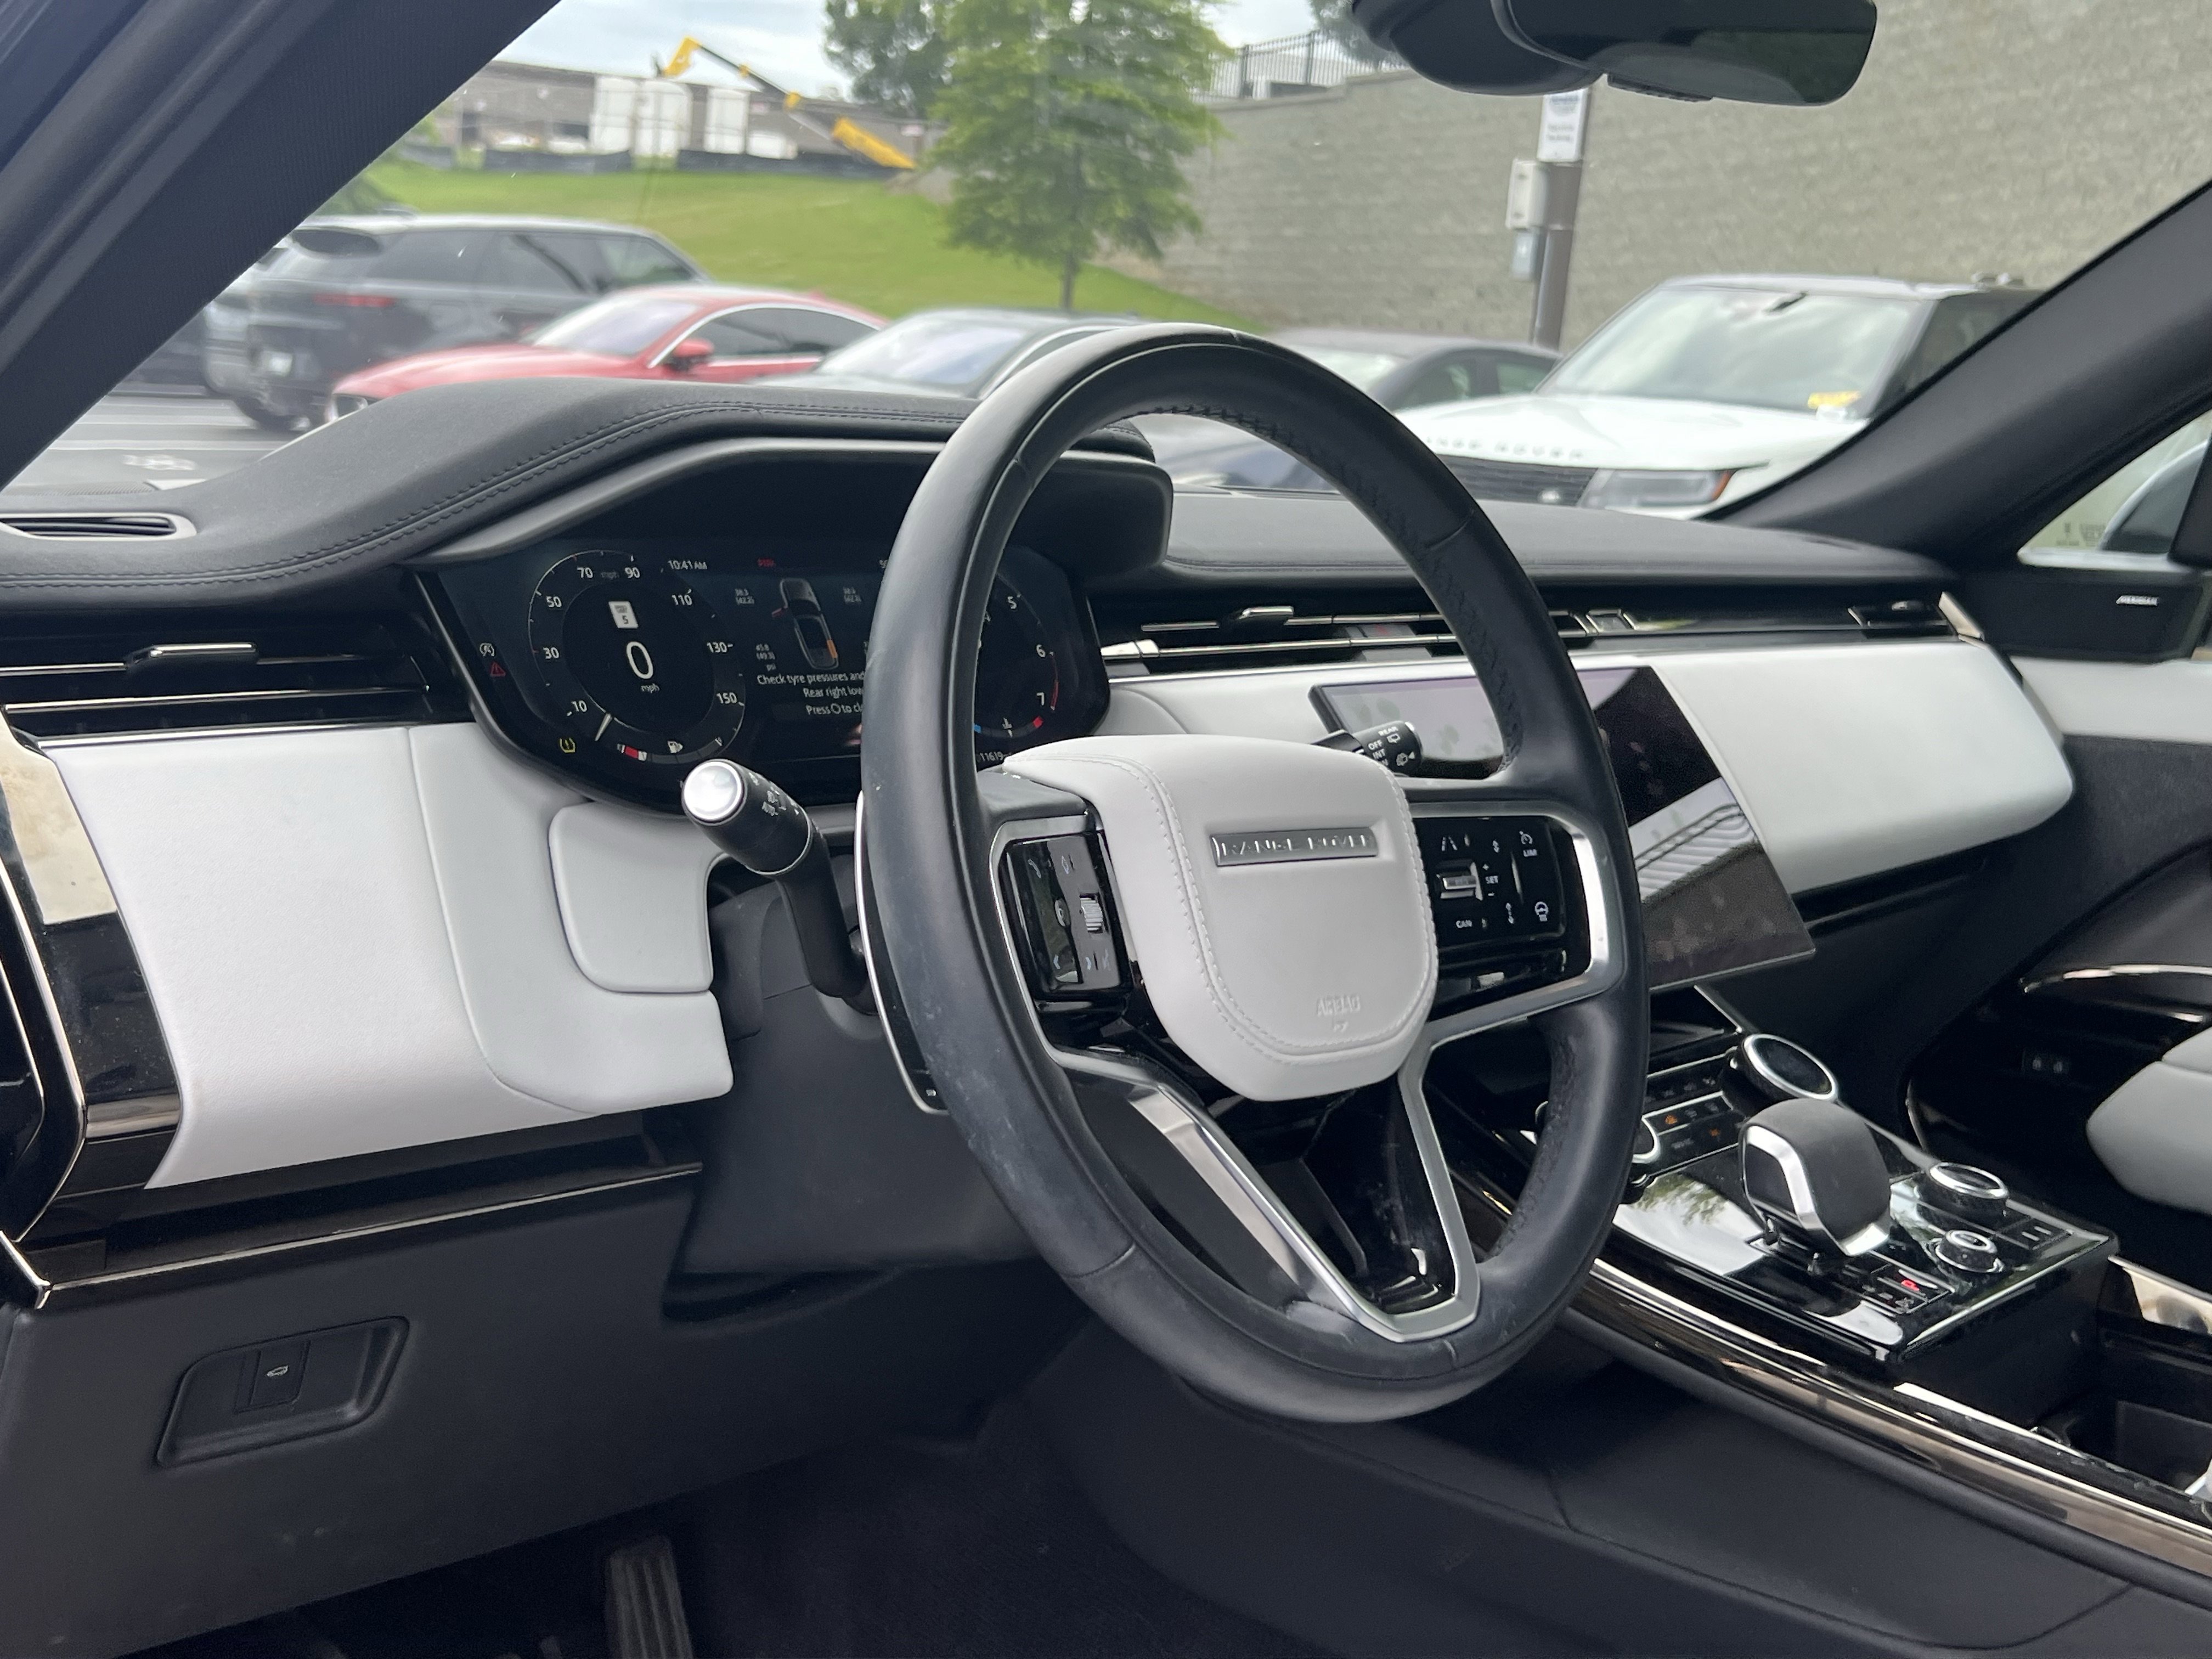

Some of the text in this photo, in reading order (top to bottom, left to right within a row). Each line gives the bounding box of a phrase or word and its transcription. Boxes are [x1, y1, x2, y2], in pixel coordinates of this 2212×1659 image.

[668, 560, 692, 570] 10:41
[577, 567, 594, 579] 70
[624, 567, 641, 579] 90
[546, 596, 562, 608] 50
[672, 594, 693, 606] 110
[1007, 596, 1017, 610] 5
[543, 647, 560, 659] 30
[707, 641, 727, 653] 130
[1036, 644, 1046, 658] 6
[626, 641, 653, 679] 0
[757, 673, 786, 685] Check
[786, 675, 806, 686] tyre
[806, 673, 849, 685] pressures
[640, 683, 660, 694] mph
[803, 687, 823, 698] Rear
[825, 686, 848, 699] right
[716, 692, 737, 704] 150
[1036, 692, 1045, 706] 7
[571, 699, 588, 713] 10
[805, 704, 831, 715] Press
[841, 704, 853, 713] to
[1368, 739, 1383, 751] OFF
[1372, 748, 1386, 760] INT
[1523, 848, 1538, 857] LIM
[1485, 875, 1499, 884] SET
[1455, 919, 1473, 928] CAN
